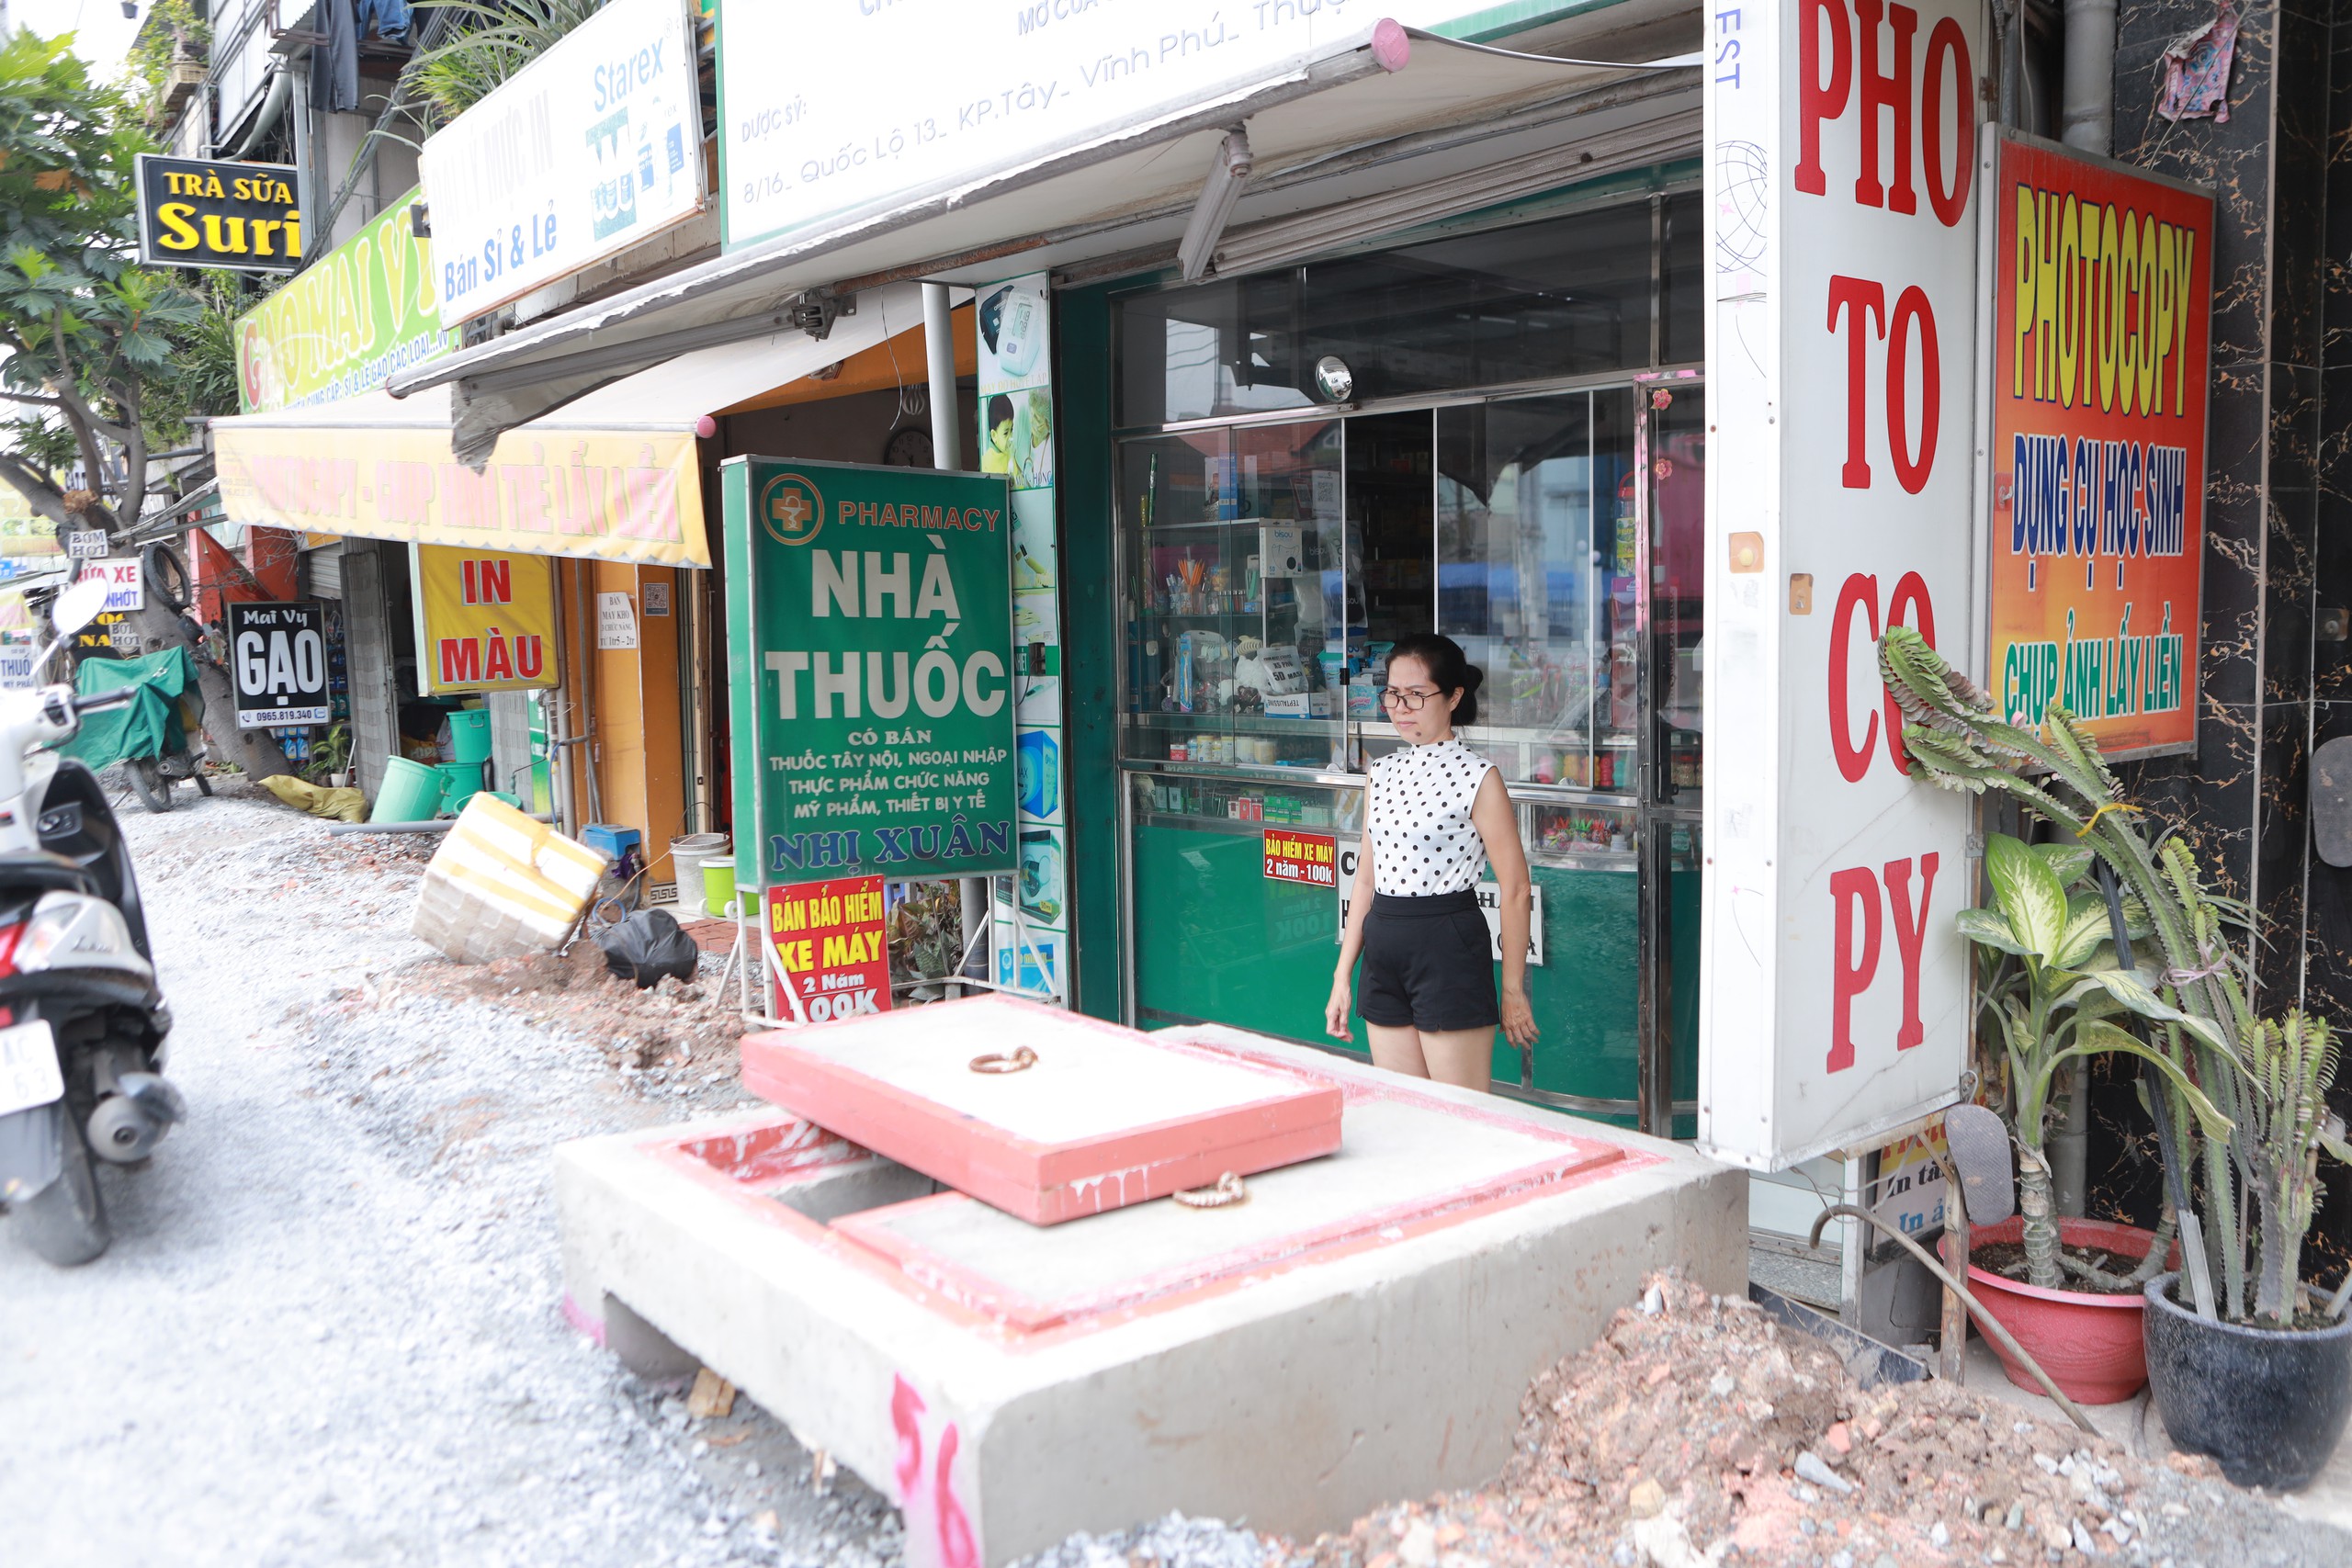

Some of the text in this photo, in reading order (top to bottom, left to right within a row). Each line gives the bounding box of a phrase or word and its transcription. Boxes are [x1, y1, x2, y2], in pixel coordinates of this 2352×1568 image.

[594, 37, 663, 112] Starex
[741, 108, 781, 142] DƯỢC
[800, 142, 866, 184] Quốc
[876, 128, 905, 160] Lộ
[1080, 47, 1148, 88] Vĩnh
[1794, 0, 1974, 227] PHO
[163, 168, 294, 204] TRÀ SỮA
[158, 202, 302, 258] Suri
[445, 252, 478, 303] Bán
[510, 224, 525, 269] &
[532, 198, 557, 259] Lẻ
[305, 236, 376, 378] MAI
[2013, 181, 2196, 419] PHOTOCOPY
[390, 343, 407, 372] CÁC
[1826, 275, 1940, 494] TO
[838, 501, 1001, 532] PHARMACY
[2011, 432, 2187, 592] DỤNG CỤ HỌC SINH
[113, 566, 137, 583] XE
[460, 558, 513, 606] IN
[811, 534, 961, 620] NHÀ
[78, 634, 111, 647] NA
[243, 609, 308, 627] Mai Vy
[237, 629, 324, 705] GẠO
[438, 627, 544, 684] MÀU
[764, 622, 1007, 720] THUỐC
[2061, 607, 2103, 723] ẢNH
[2105, 602, 2142, 720] LẤY
[2142, 601, 2184, 715] LIỀN
[256, 709, 312, 722] 0965.819.340
[848, 727, 932, 745] CÓ BÁN
[769, 746, 1007, 771] THUỐC TÂY NỘI, NGOẠI NHẬP
[788, 770, 989, 796] THỰC PHẨM CHỨC NĂNG
[794, 789, 986, 818] MỸ PHẨM, THIẾT BỊ Y TẾ
[769, 813, 1010, 874] NHỊ XUÂN
[1265, 833, 1333, 863] BẢO HIỂM XE MÁY
[1266, 858, 1273, 874] 2
[1275, 860, 1299, 878] năm
[1306, 863, 1333, 883] 100k
[772, 880, 883, 933] BÁN BẢO HIỂM
[775, 926, 884, 974] XE MÁY
[1826, 852, 1939, 1075] PY
[803, 973, 865, 994] 2 Năm
[1888, 1174, 1911, 1198] In
[1900, 1212, 1923, 1234] In
